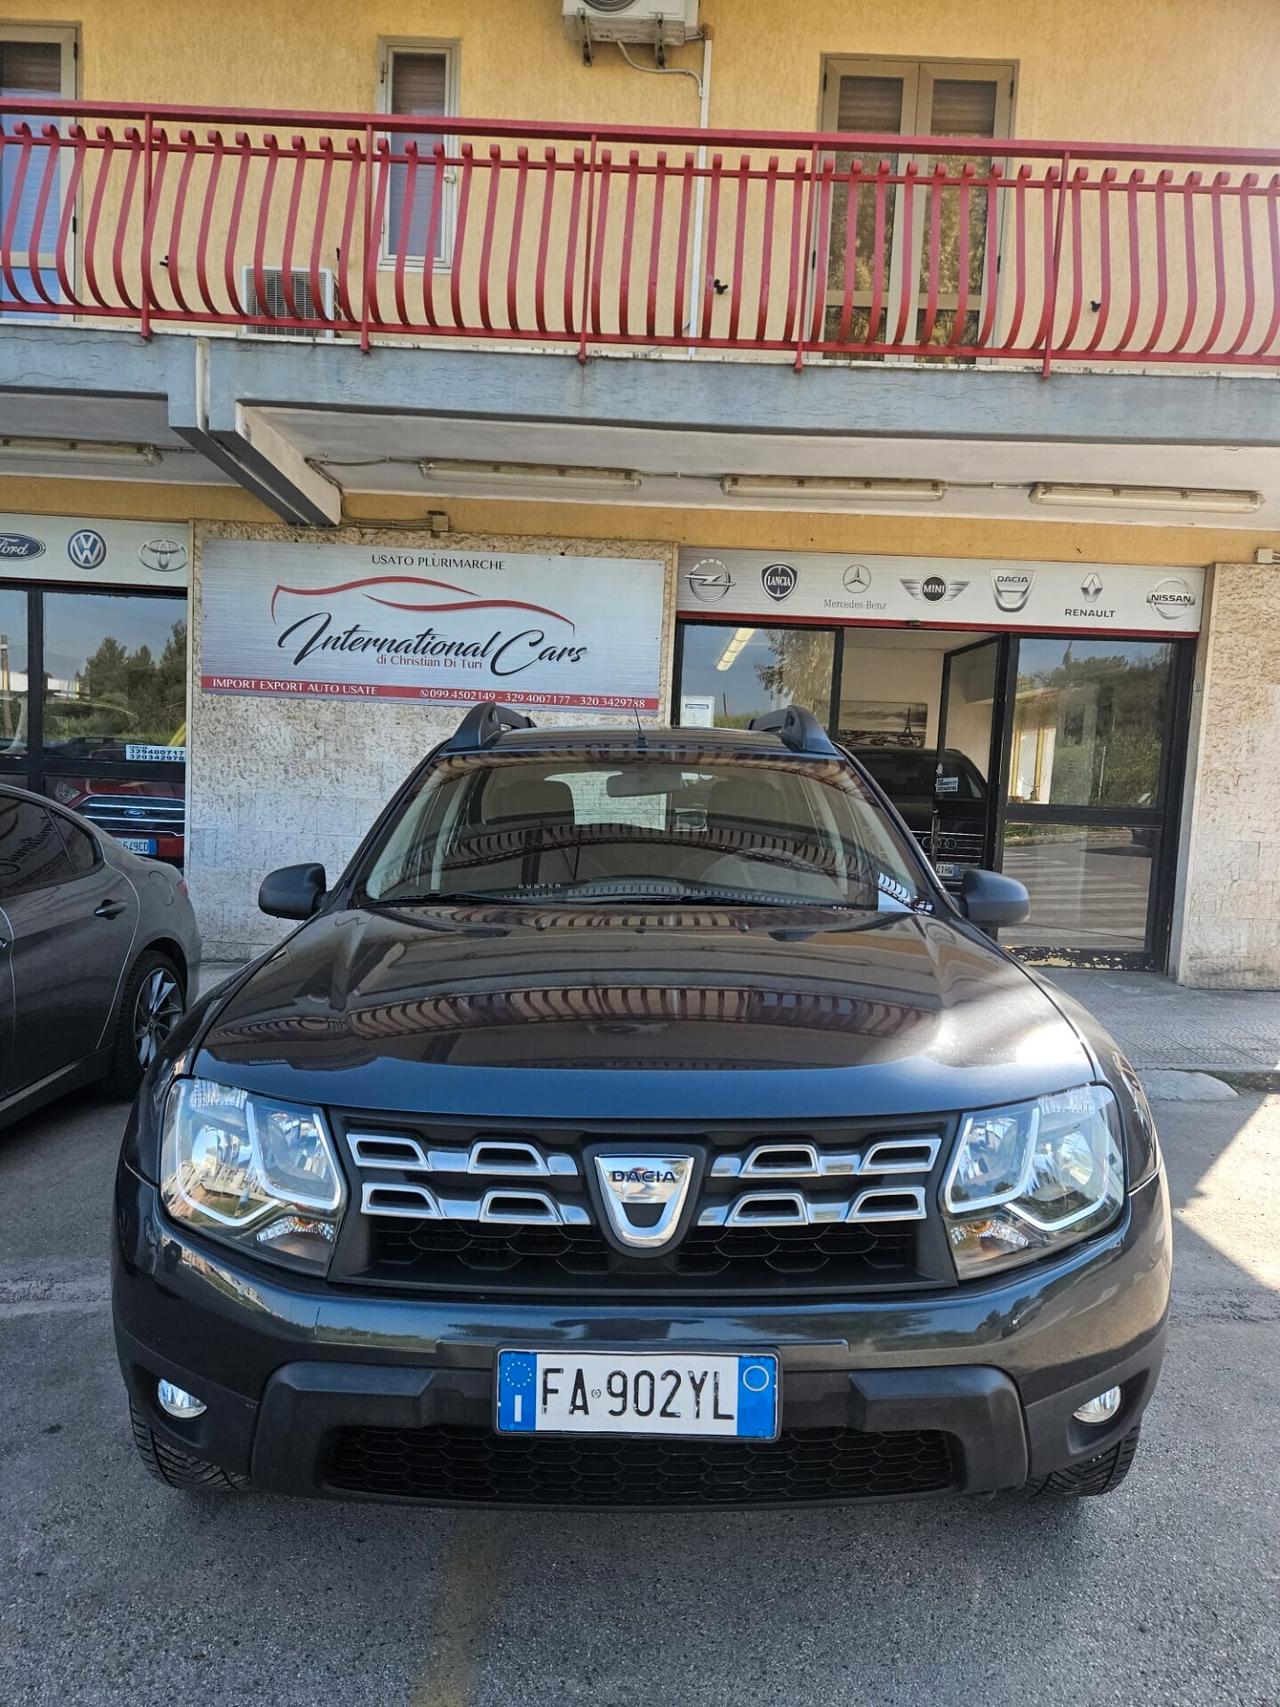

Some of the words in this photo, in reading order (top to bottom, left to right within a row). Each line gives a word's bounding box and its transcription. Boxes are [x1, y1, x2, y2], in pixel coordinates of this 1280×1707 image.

[371, 554, 414, 566] USATO
[418, 556, 506, 570] PLURIMARCHE
[767, 575, 791, 587] LANCIA
[996, 575, 1029, 584] DACIA
[922, 584, 945, 594] MINI
[823, 598, 887, 610] Mercedes-Benz
[1150, 593, 1192, 603] NISSAN
[1064, 608, 1116, 618] RENAULT
[277, 612, 502, 666] International
[490, 629, 589, 676] Cars
[376, 654, 387, 665] di
[390, 655, 441, 667] Christian
[444, 657, 457, 668] Di
[461, 658, 483, 669] Turi
[213, 677, 256, 689] IMPORT
[260, 680, 304, 692] EXPORT
[307, 683, 339, 694] AUTO
[342, 684, 379, 696] USATE
[429, 689, 496, 701] 099.4502149
[612, 1170, 676, 1183] DACIA
